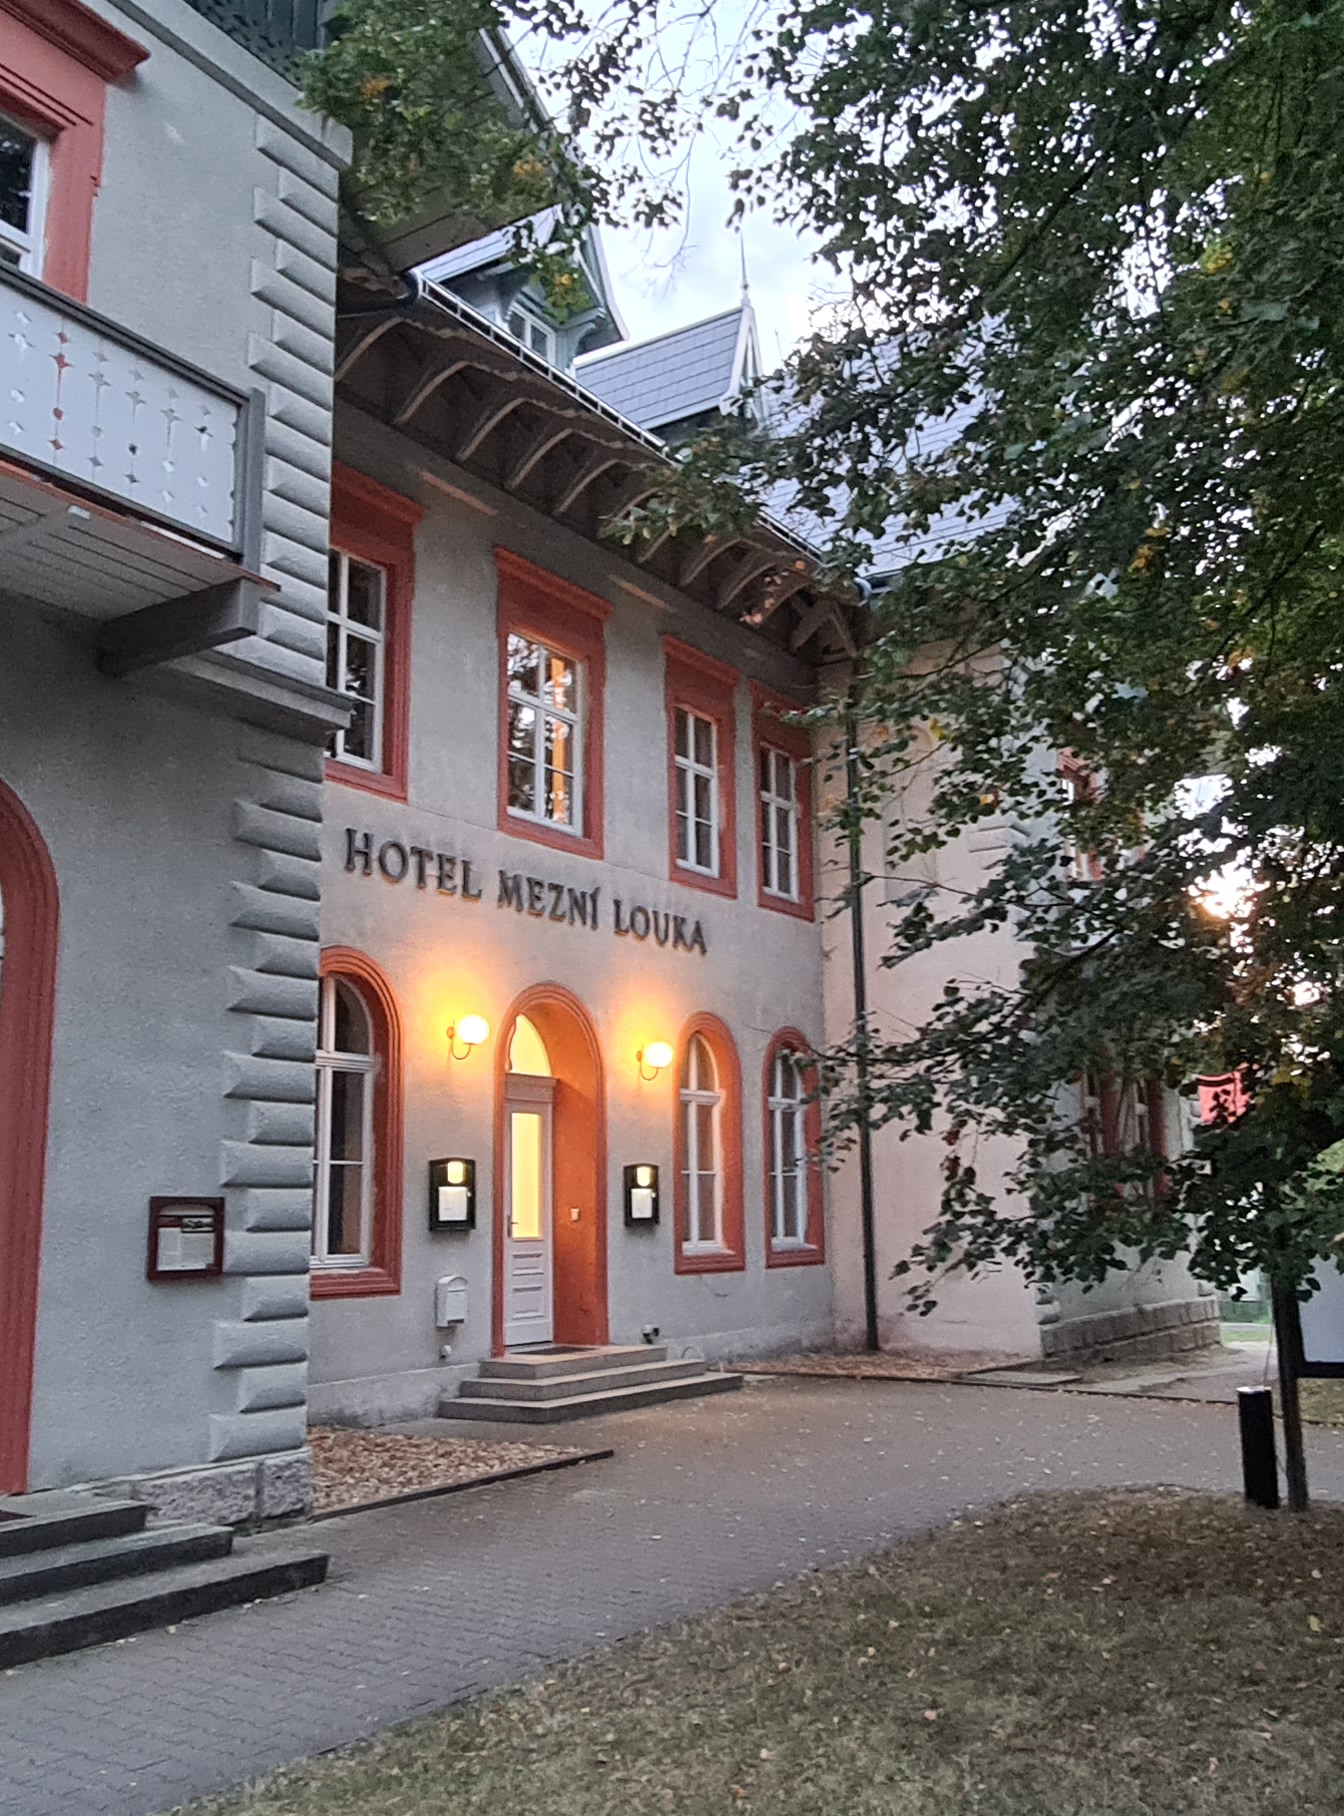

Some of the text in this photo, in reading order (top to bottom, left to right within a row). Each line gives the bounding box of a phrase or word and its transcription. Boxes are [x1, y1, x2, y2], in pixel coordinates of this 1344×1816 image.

[344, 827, 708, 956] HOTEL MEZNÍ LOUKA
